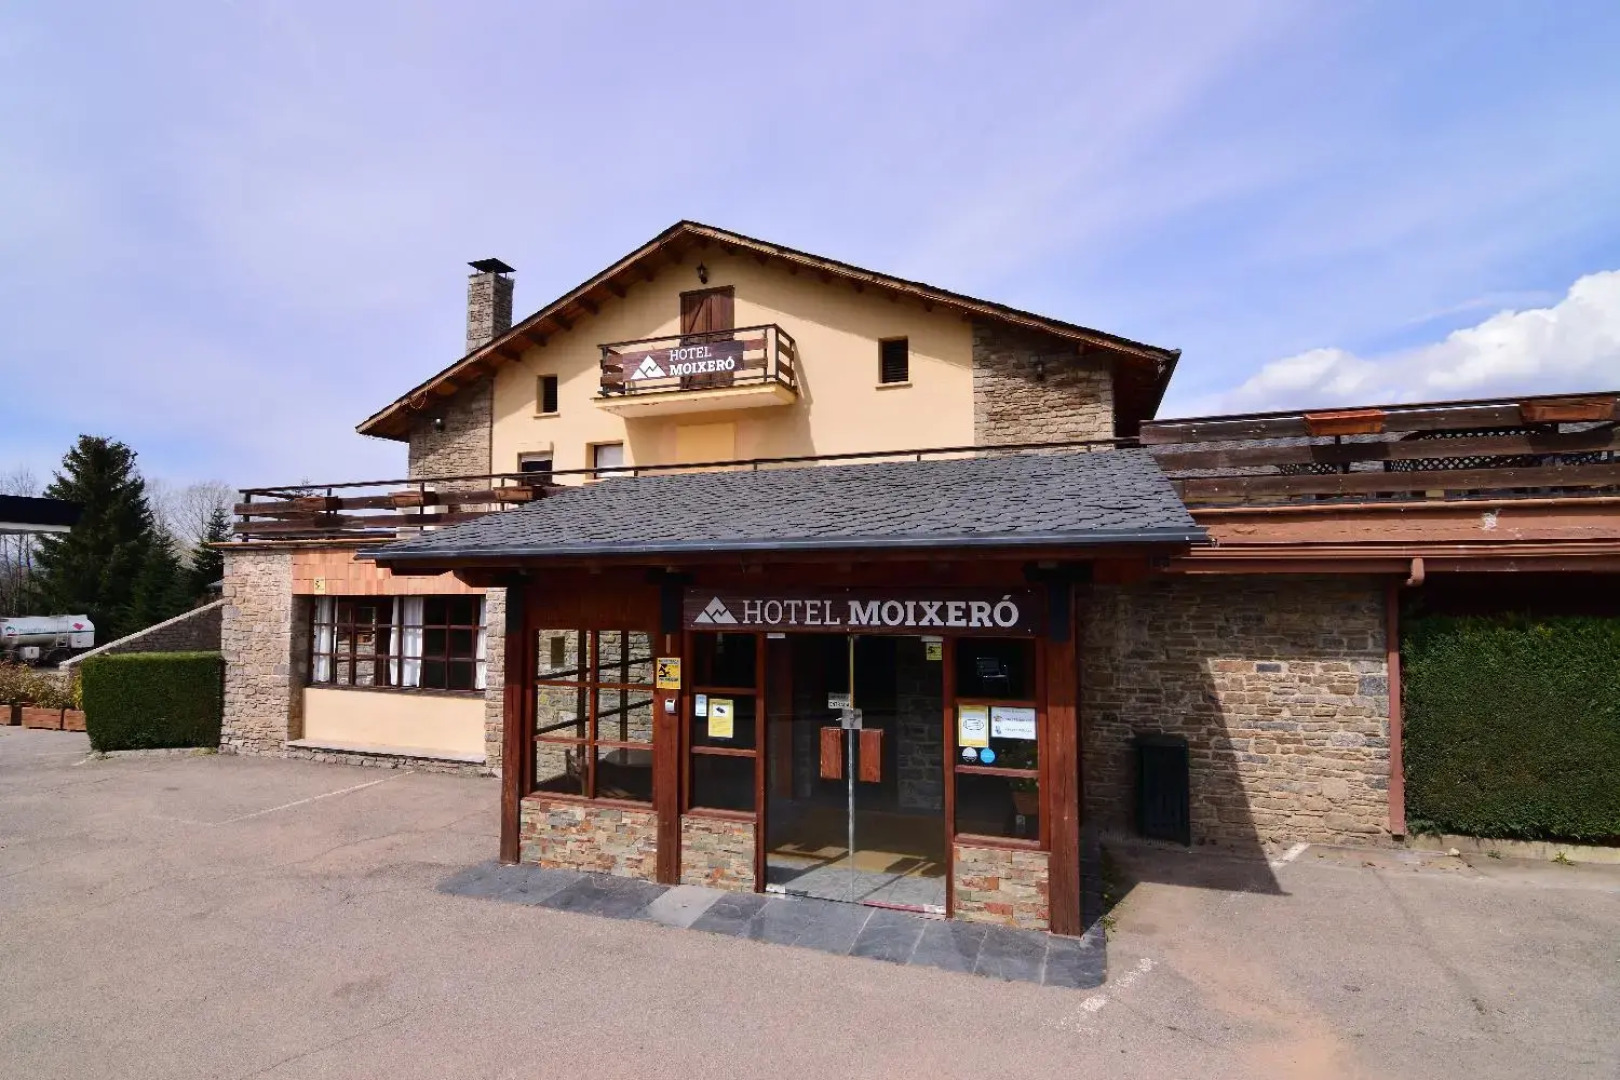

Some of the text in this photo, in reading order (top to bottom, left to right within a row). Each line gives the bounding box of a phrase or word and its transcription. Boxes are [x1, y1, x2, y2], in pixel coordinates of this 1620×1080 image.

[669, 346, 712, 361] HOTEL
[669, 356, 735, 376] MOIXERÓ
[742, 595, 1019, 627] HOTEL MOIXERÓ
